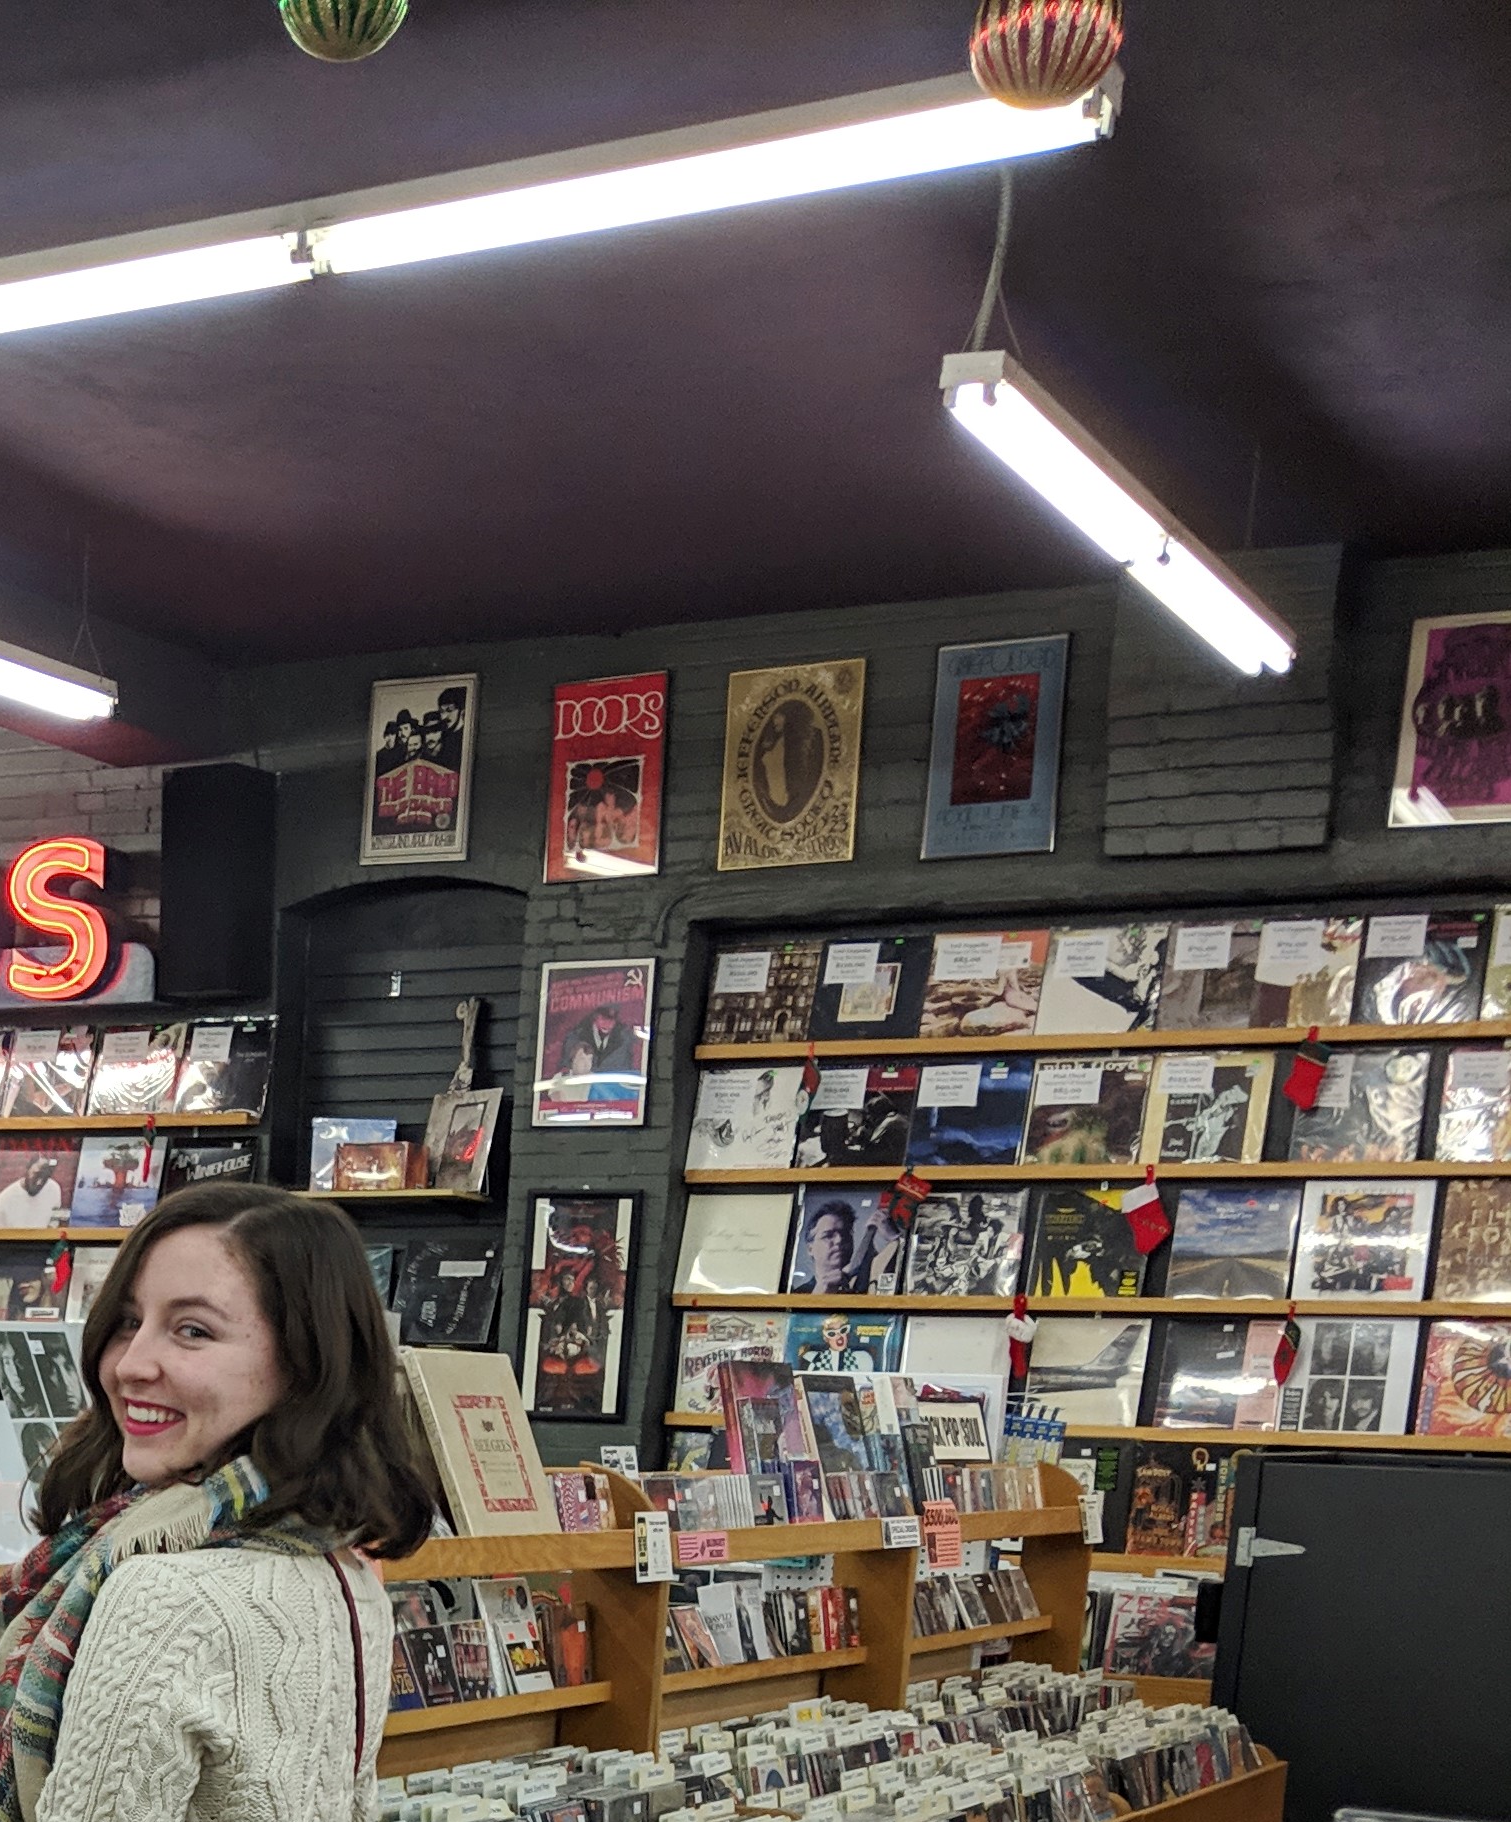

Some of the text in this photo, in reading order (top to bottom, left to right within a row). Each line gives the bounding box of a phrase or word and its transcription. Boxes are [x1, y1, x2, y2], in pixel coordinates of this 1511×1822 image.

[554, 691, 664, 740] DOORS
[550, 985, 645, 1012] COMMUNISM
[187, 1152, 252, 1181] WINEHOUSE
